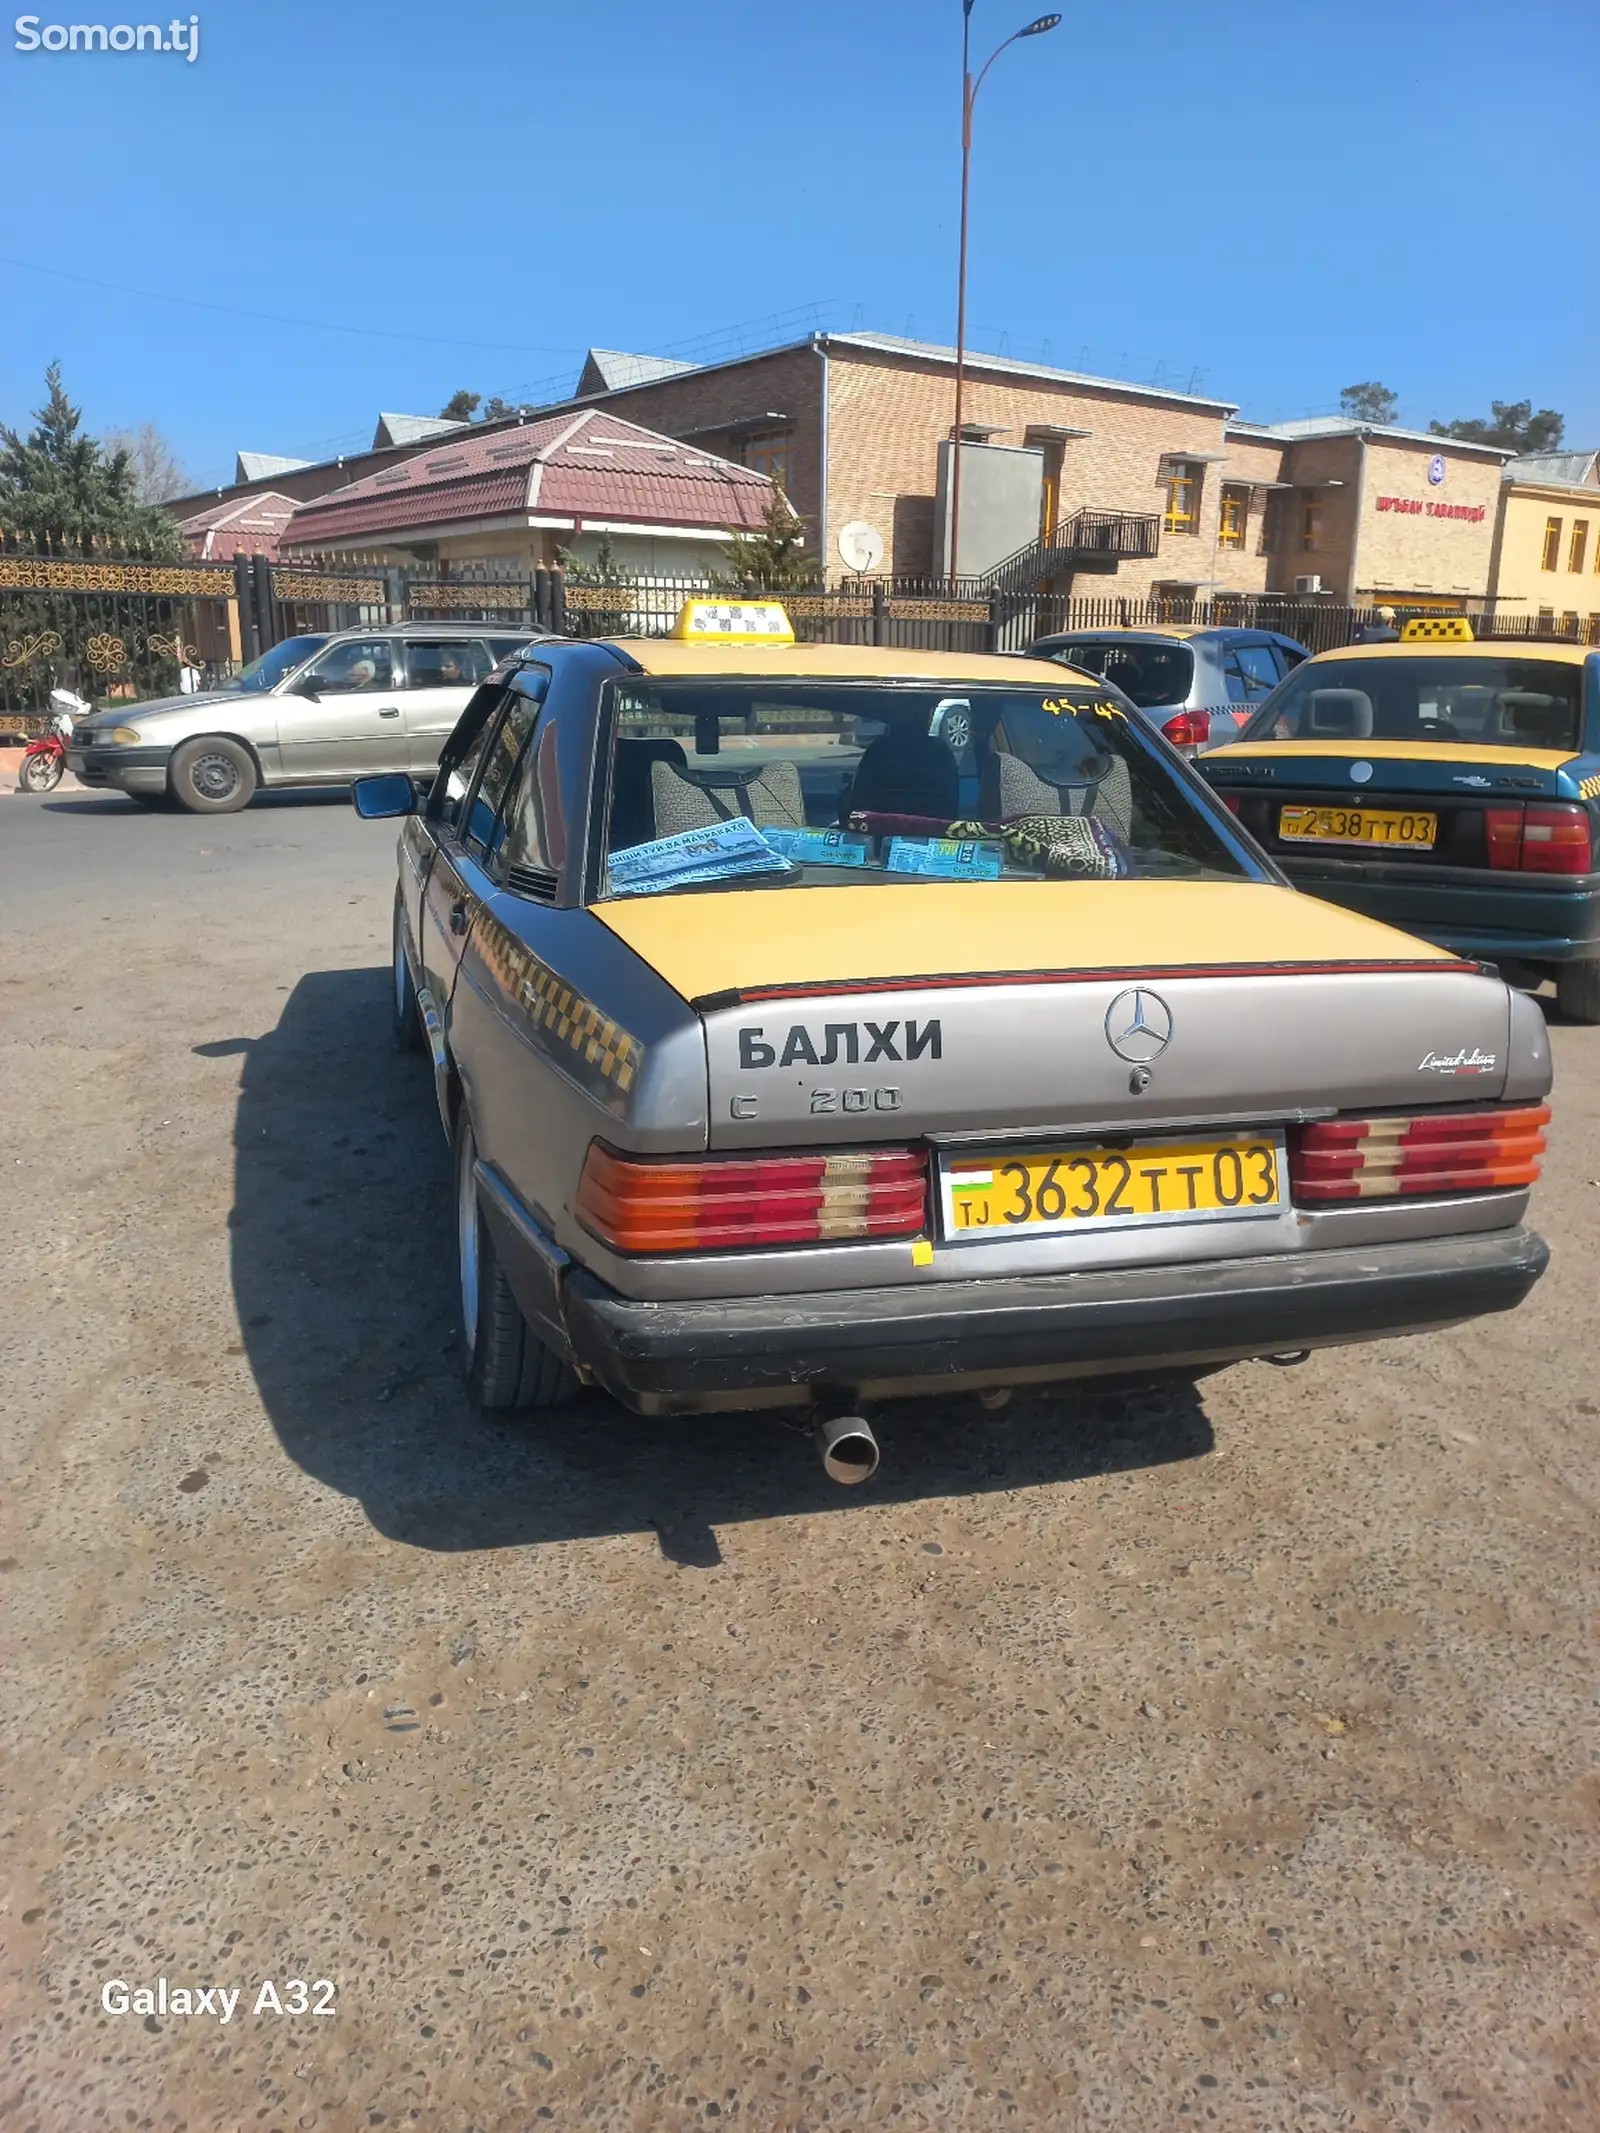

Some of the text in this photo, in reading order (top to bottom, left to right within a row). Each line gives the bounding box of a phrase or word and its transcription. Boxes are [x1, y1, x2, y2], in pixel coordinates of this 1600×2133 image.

[738, 1019, 943, 1070] БАЛХИ
[810, 1086, 903, 1114] 200
[959, 1201, 990, 1226] TJ
